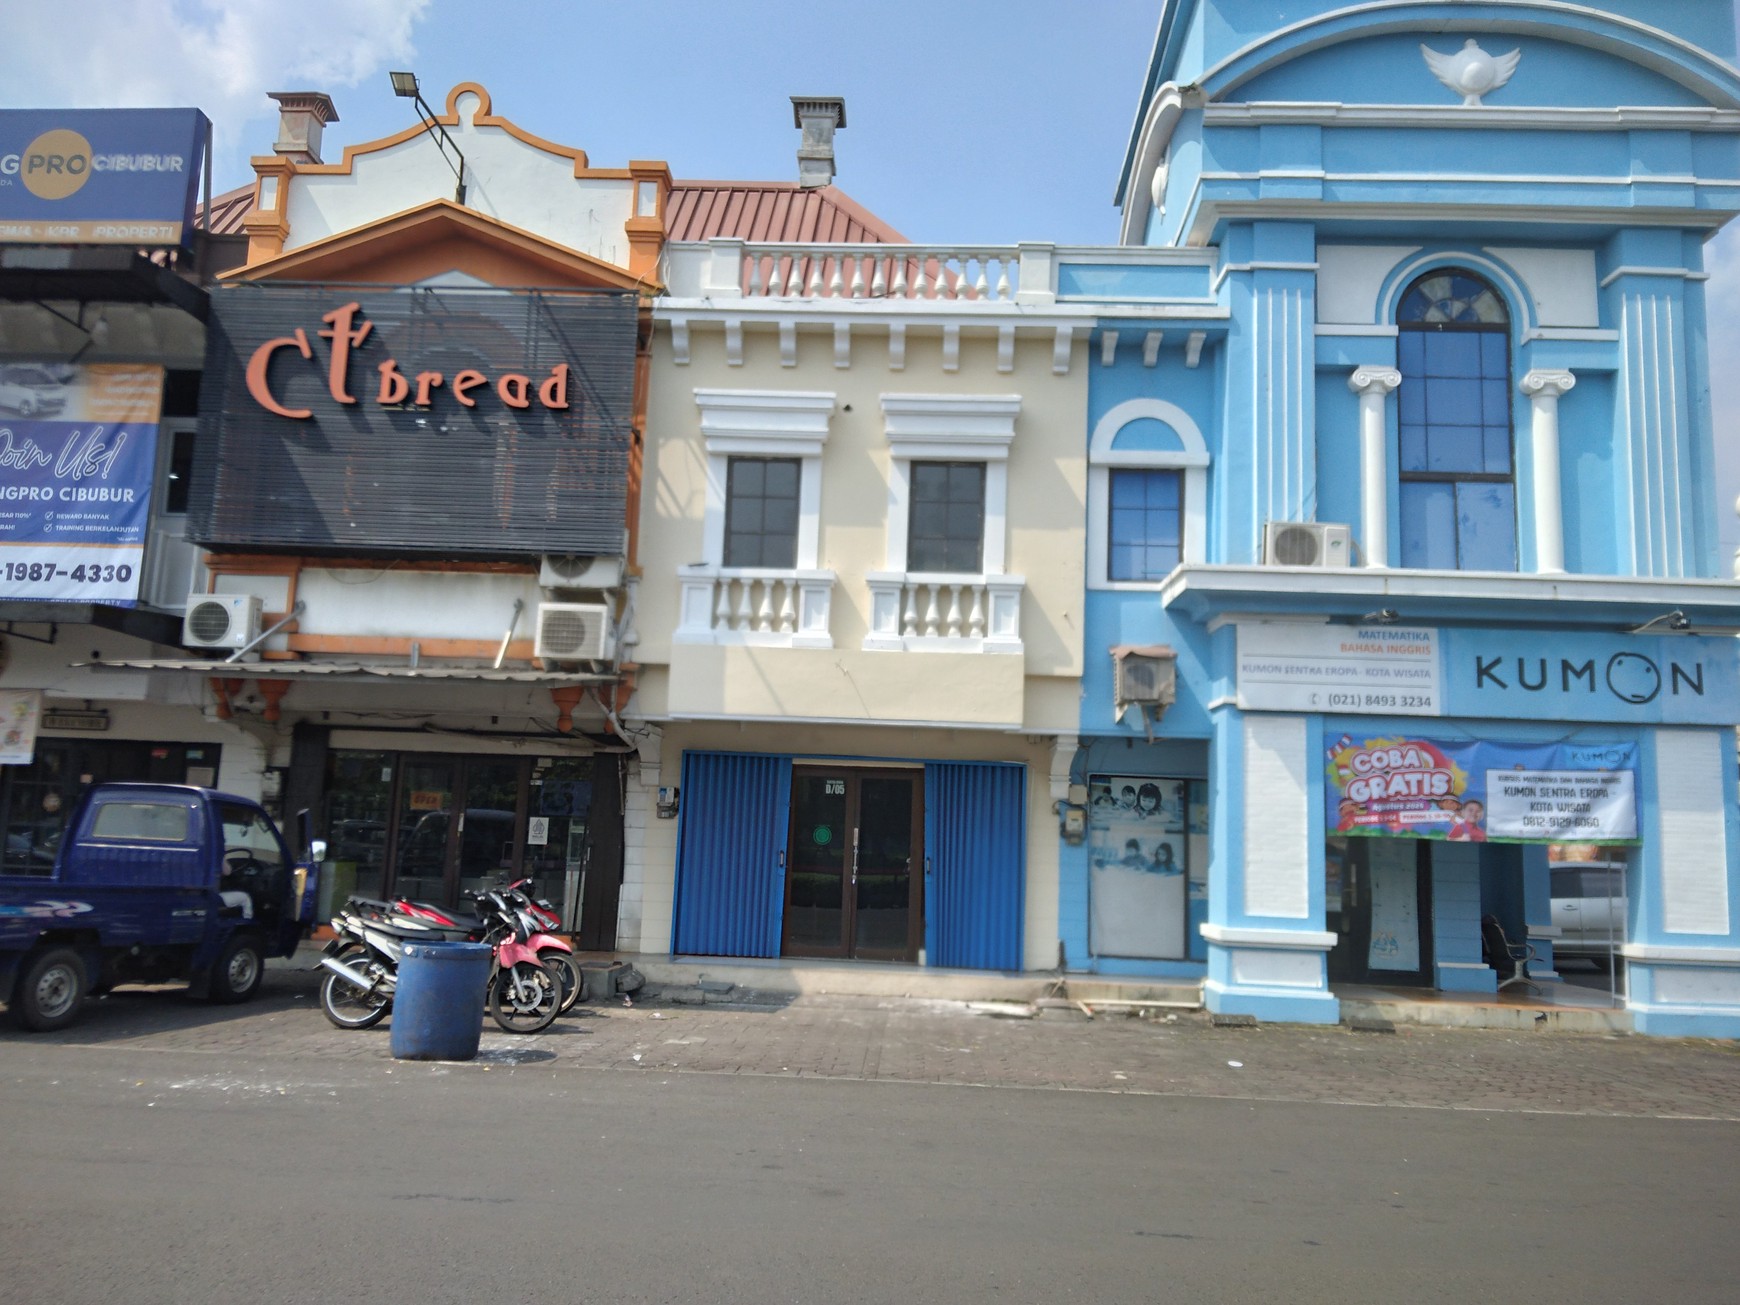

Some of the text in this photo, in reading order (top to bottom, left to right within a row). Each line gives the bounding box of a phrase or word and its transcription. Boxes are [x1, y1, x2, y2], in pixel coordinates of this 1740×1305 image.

[27, 154, 88, 175] PRO
[92, 154, 184, 172] CIBUBUR
[93, 225, 174, 239] PROPERTI
[376, 359, 569, 409] bread
[54, 425, 128, 480] Us!
[59, 487, 135, 503] CIBUBUR
[0, 562, 132, 583] 1987-4330
[1357, 630, 1431, 642] MATEMATIKA
[1340, 643, 1432, 656] BAHASA INGGRIS
[1241, 663, 1283, 675] KUMON
[1284, 664, 1323, 676] SENTRA
[1324, 666, 1358, 677] EROPA
[1365, 667, 1391, 678] KOTA
[1393, 668, 1432, 680] WISATA
[1475, 651, 1705, 705] KUMON
[1328, 692, 1432, 708] (021) 8493 3234
[1352, 747, 1422, 772] COBA
[1571, 750, 1632, 764] KUMON
[825, 784, 846, 795] D/05
[1349, 771, 1451, 803] GRATIS
[1503, 786, 1537, 798] KUMON
[1540, 786, 1577, 799] SENTRA
[1579, 787, 1609, 800] EROPA
[1529, 802, 1592, 814] KOTA WISATA
